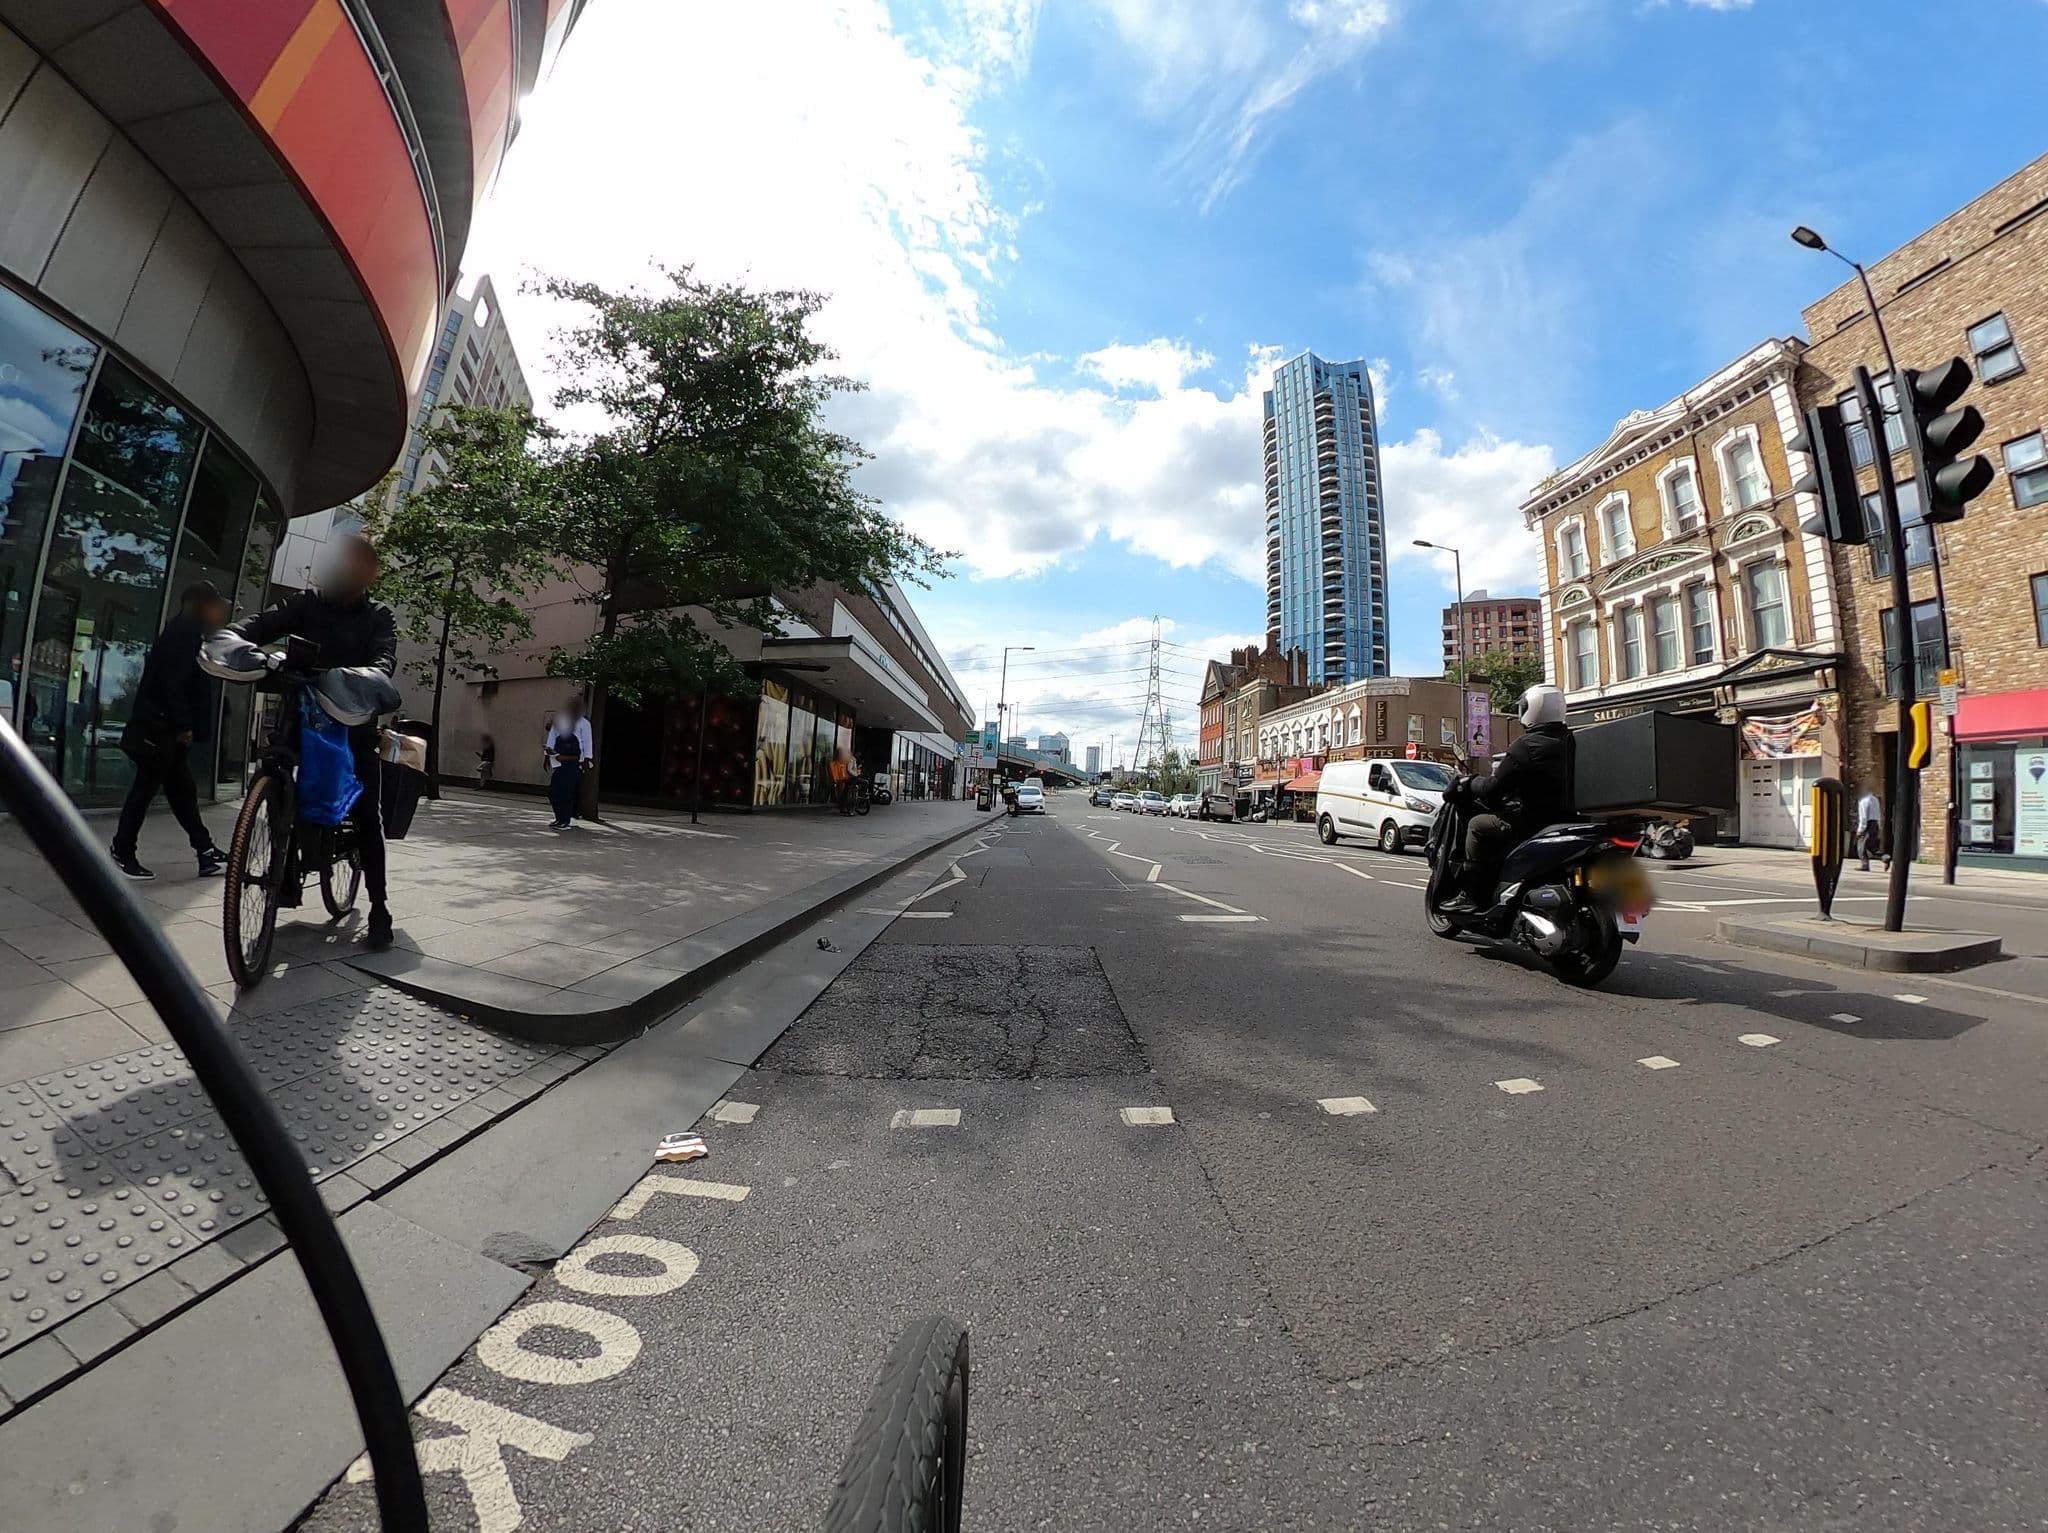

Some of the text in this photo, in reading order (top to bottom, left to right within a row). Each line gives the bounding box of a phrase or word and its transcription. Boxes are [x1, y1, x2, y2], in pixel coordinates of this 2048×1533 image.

[1377, 701, 1385, 735] EFES
[1366, 749, 1394, 758] EFES
[346, 1173, 751, 1533] LOOK
